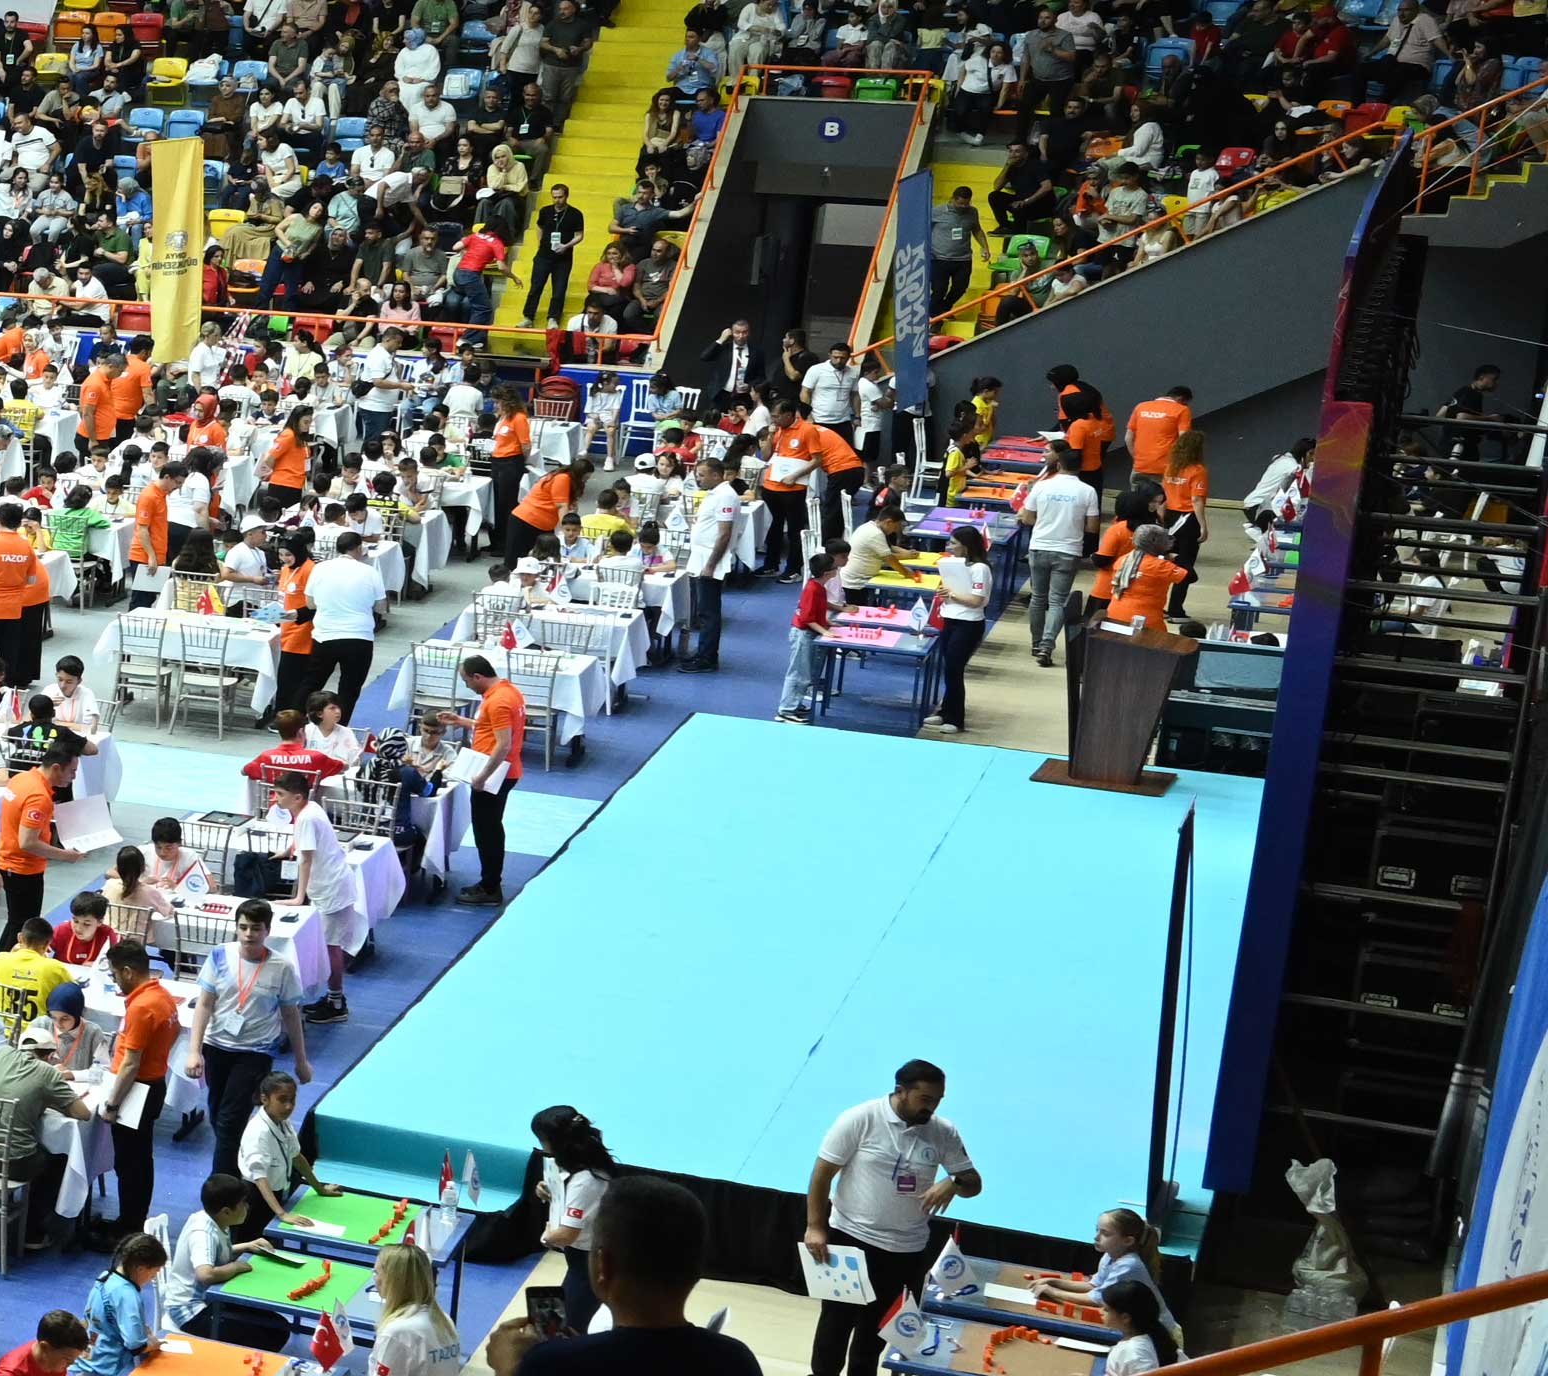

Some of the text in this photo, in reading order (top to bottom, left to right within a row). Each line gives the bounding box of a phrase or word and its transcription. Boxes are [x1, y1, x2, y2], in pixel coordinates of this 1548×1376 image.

[824, 122, 840, 136] B
[1, 554, 29, 563] TAZOF
[269, 754, 313, 765] YALOVA
